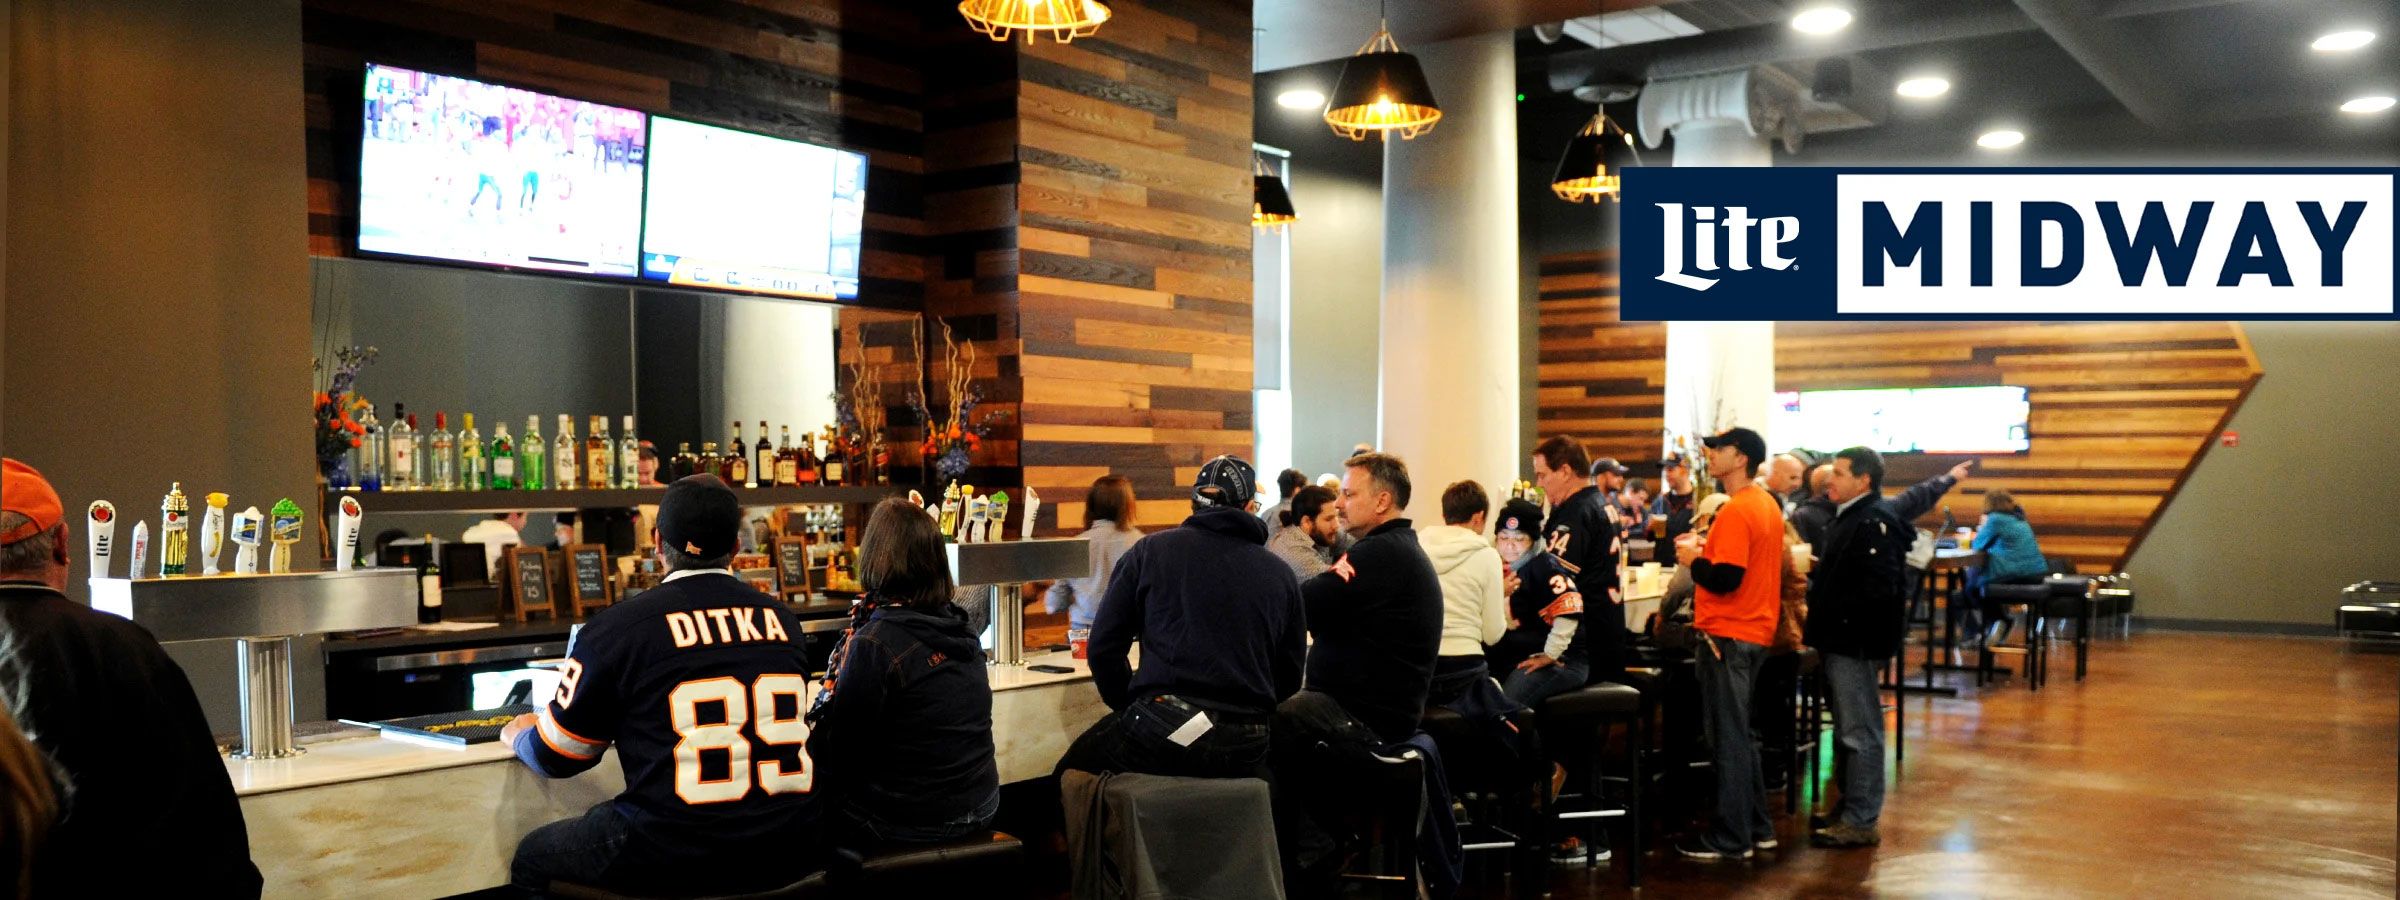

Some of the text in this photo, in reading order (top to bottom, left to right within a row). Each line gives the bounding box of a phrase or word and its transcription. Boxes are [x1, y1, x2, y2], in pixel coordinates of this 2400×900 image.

[96, 535, 109, 557] Lite
[664, 607, 789, 648] DITKA
[668, 673, 814, 805] 89
